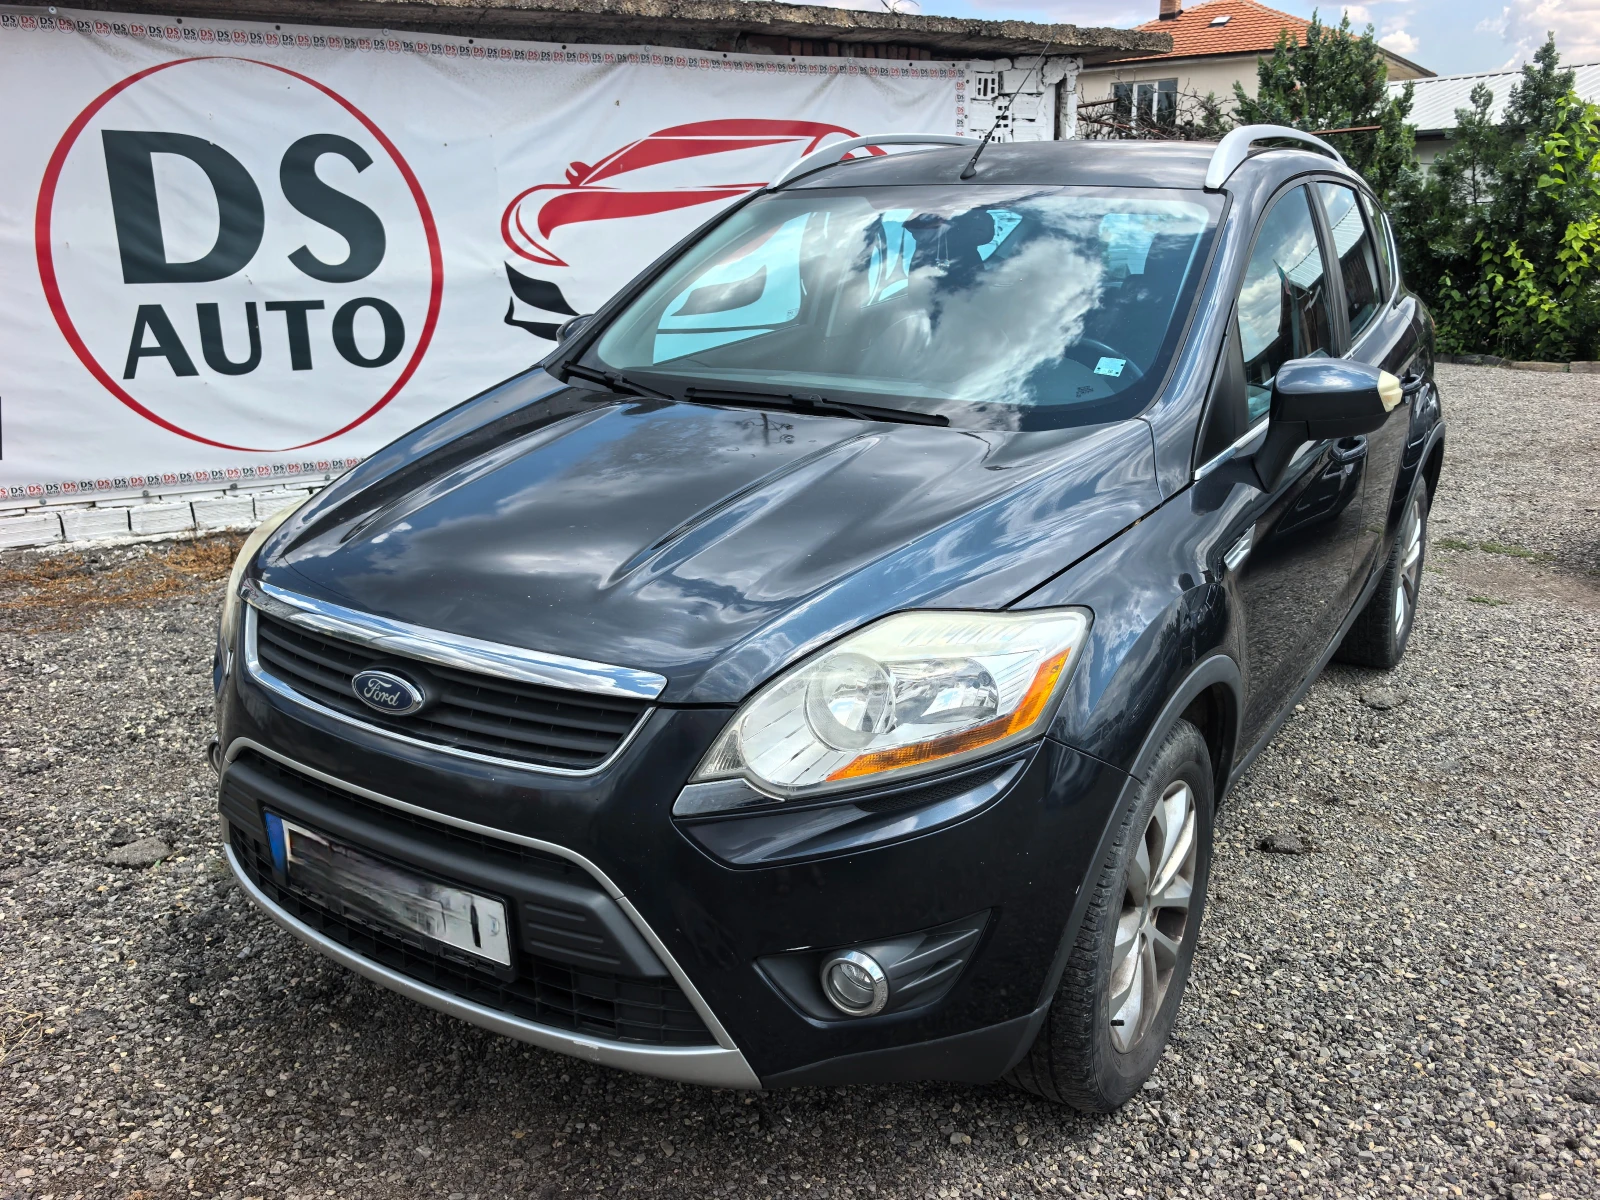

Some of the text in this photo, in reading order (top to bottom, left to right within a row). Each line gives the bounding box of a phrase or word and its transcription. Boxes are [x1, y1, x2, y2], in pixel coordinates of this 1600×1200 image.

[101, 129, 386, 284] DS
[123, 297, 405, 379] AUTO
[364, 678, 400, 706] Ford
